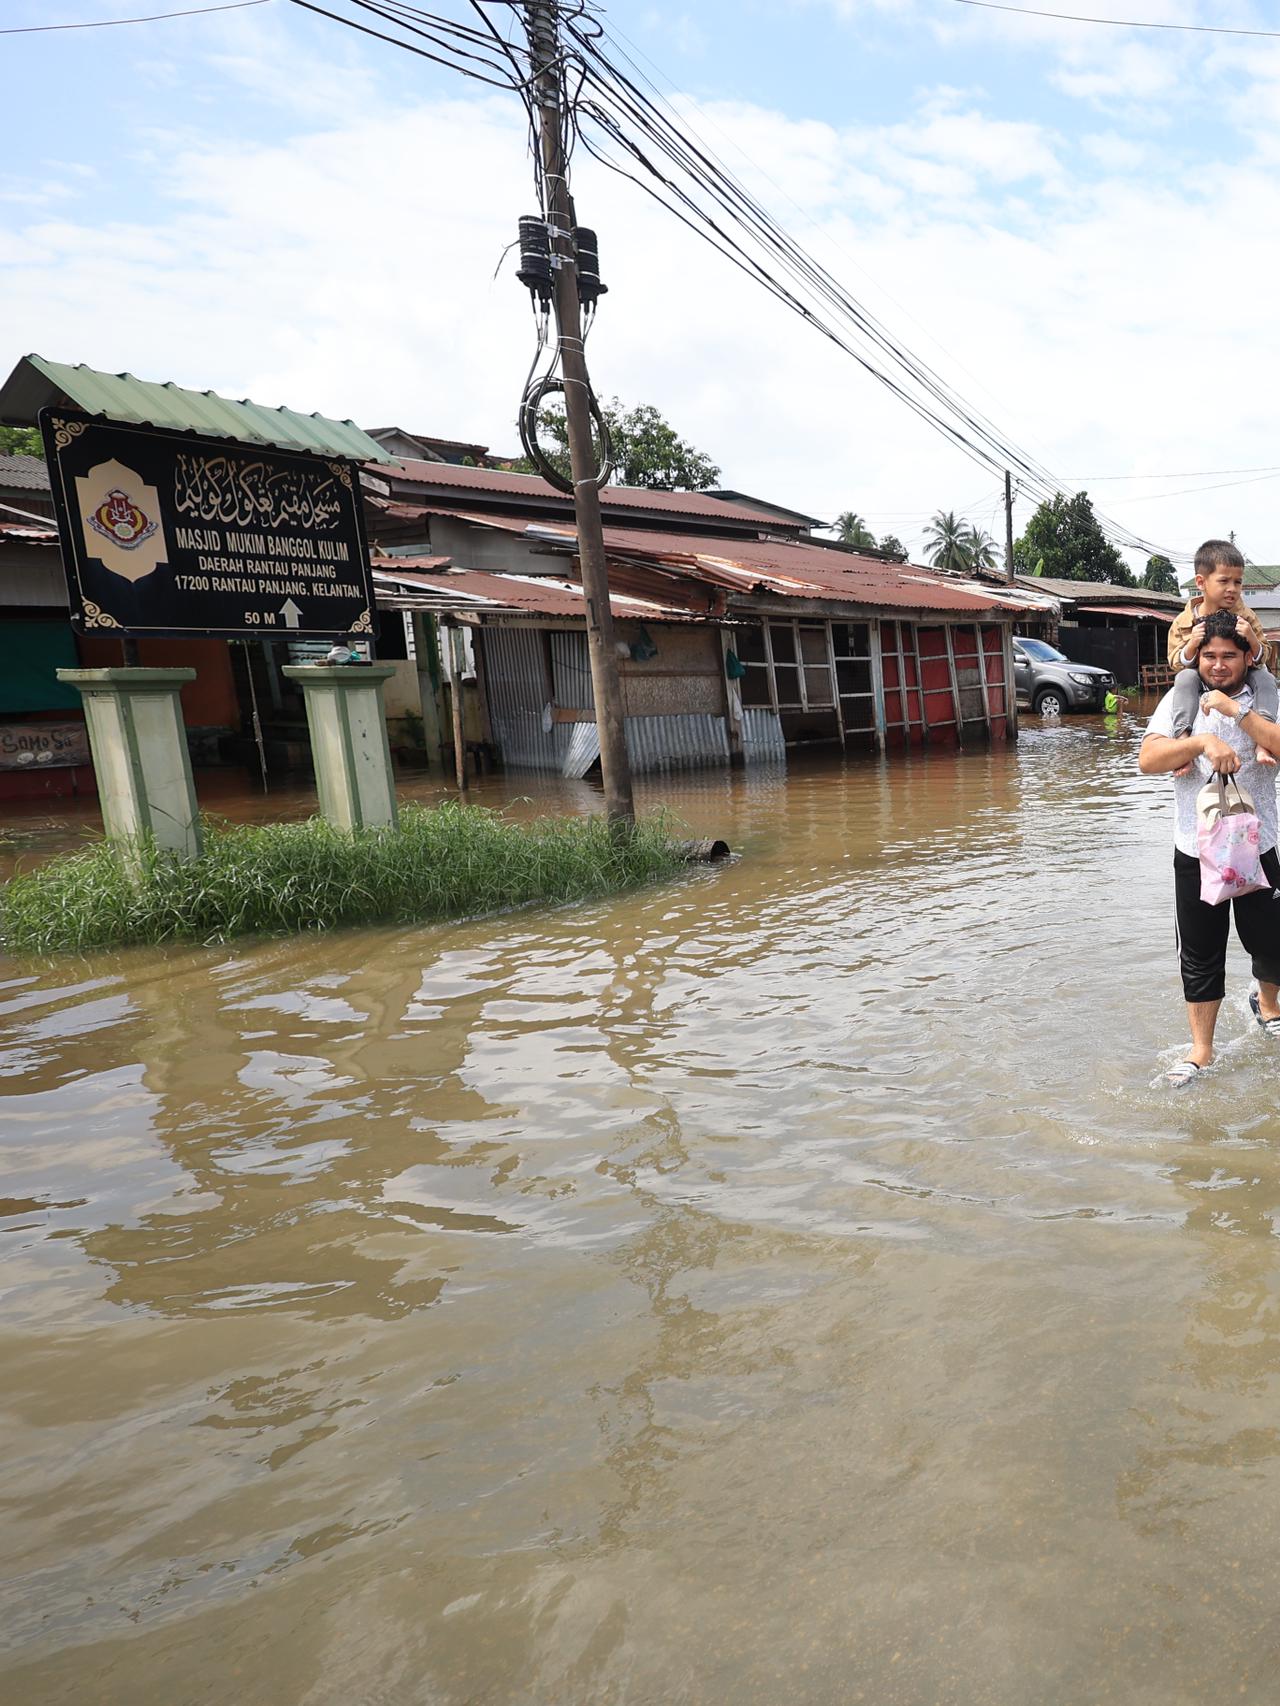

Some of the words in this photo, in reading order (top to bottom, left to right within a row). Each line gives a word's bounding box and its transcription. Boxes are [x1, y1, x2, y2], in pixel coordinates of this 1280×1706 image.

[175, 527, 221, 551] MASJID
[226, 531, 266, 555] MUKIM
[267, 535, 317, 559] BANGGOL
[318, 540, 349, 562] KULIM
[198, 555, 244, 573] DAERAH
[247, 558, 288, 576] RANTAU
[291, 562, 336, 579] PANJANG
[174, 574, 209, 591] 17200
[212, 577, 256, 593] RANTAU
[312, 582, 363, 599] KELANTAN.
[244, 611, 261, 624] 50
[264, 612, 276, 625] M
